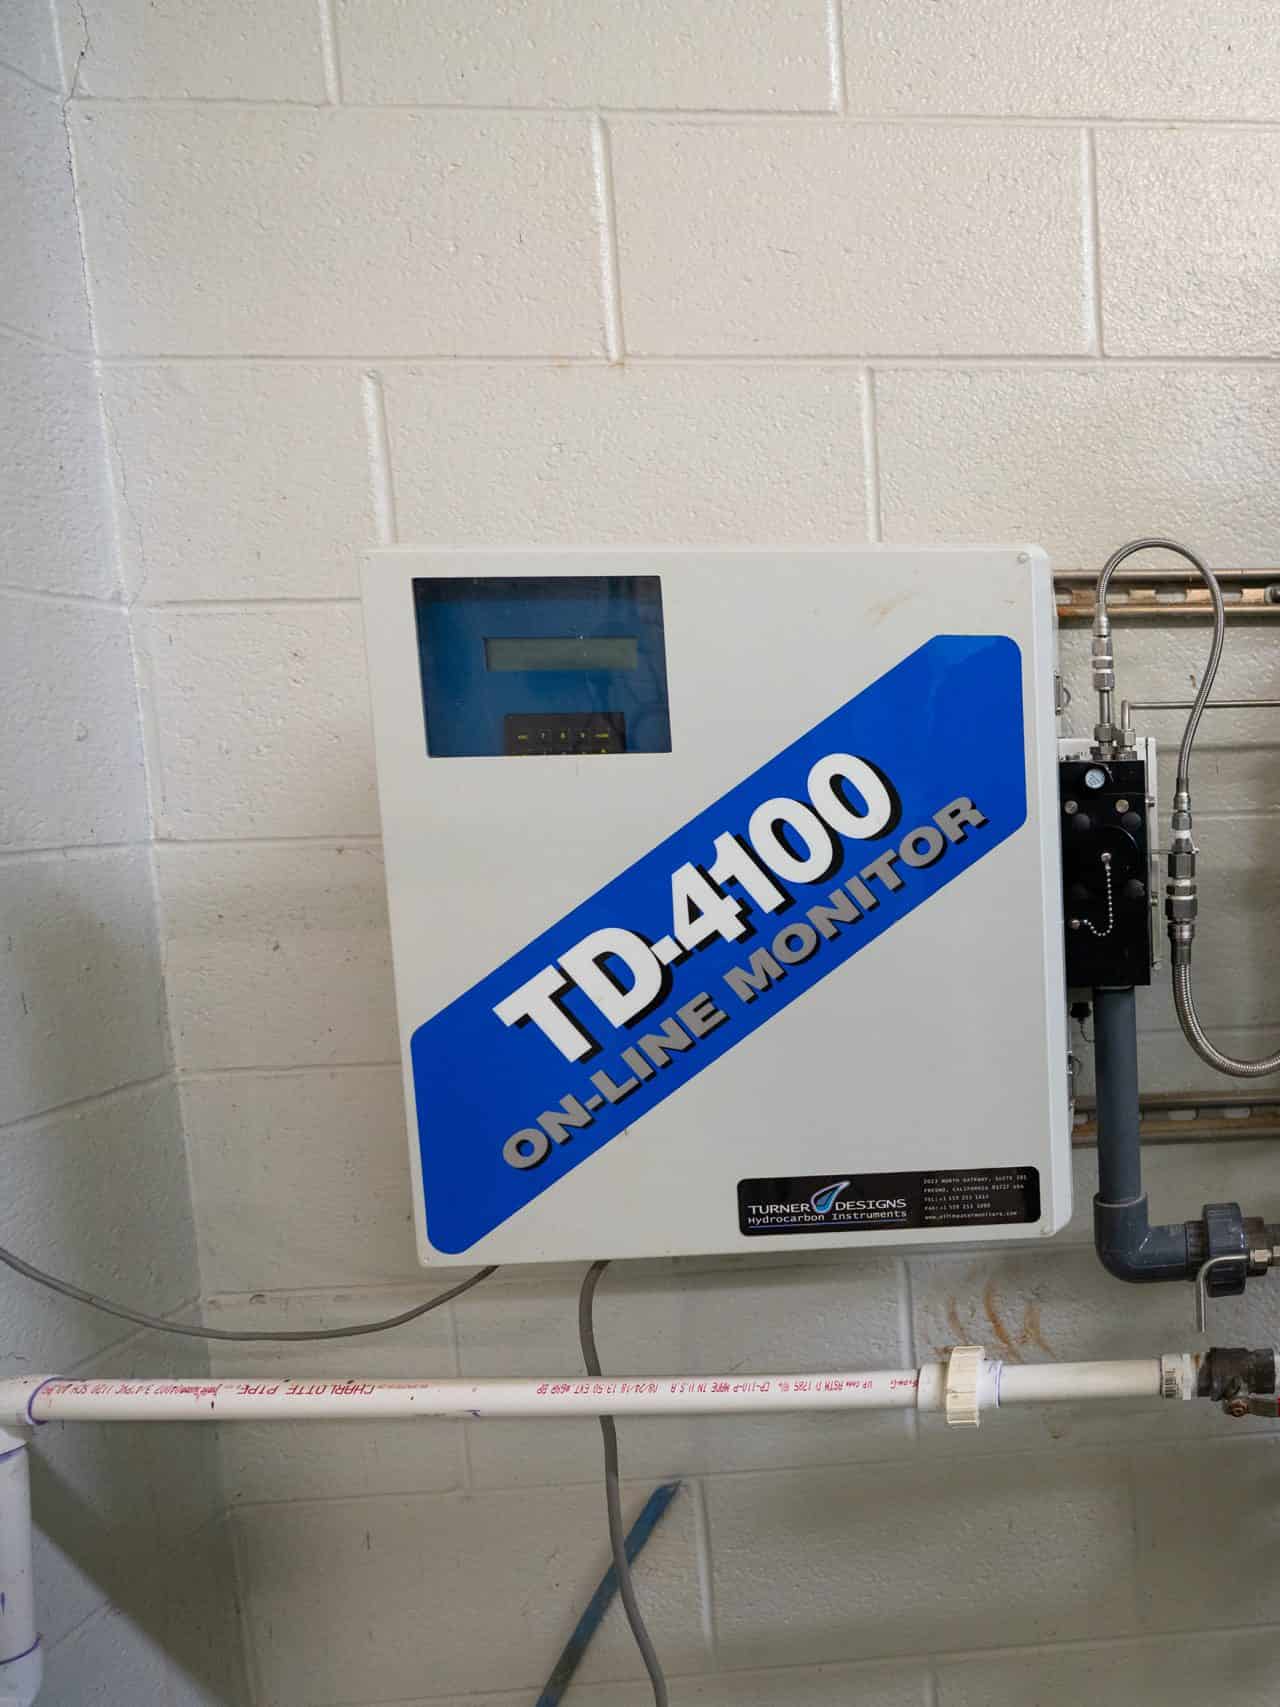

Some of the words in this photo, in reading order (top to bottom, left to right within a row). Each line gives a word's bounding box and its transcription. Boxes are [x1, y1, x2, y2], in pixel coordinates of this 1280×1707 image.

[502, 994, 727, 1170] ON-LINE
[732, 797, 988, 1004] MONITOR
[748, 1203, 812, 1214] TURNER
[835, 1198, 907, 1211] DESIGNS
[748, 1213, 825, 1225] Hydrocarbon
[832, 1210, 907, 1221] Instruments
[240, 1384, 279, 1396] PIPE
[285, 1383, 375, 1396] CHARLOTTE
